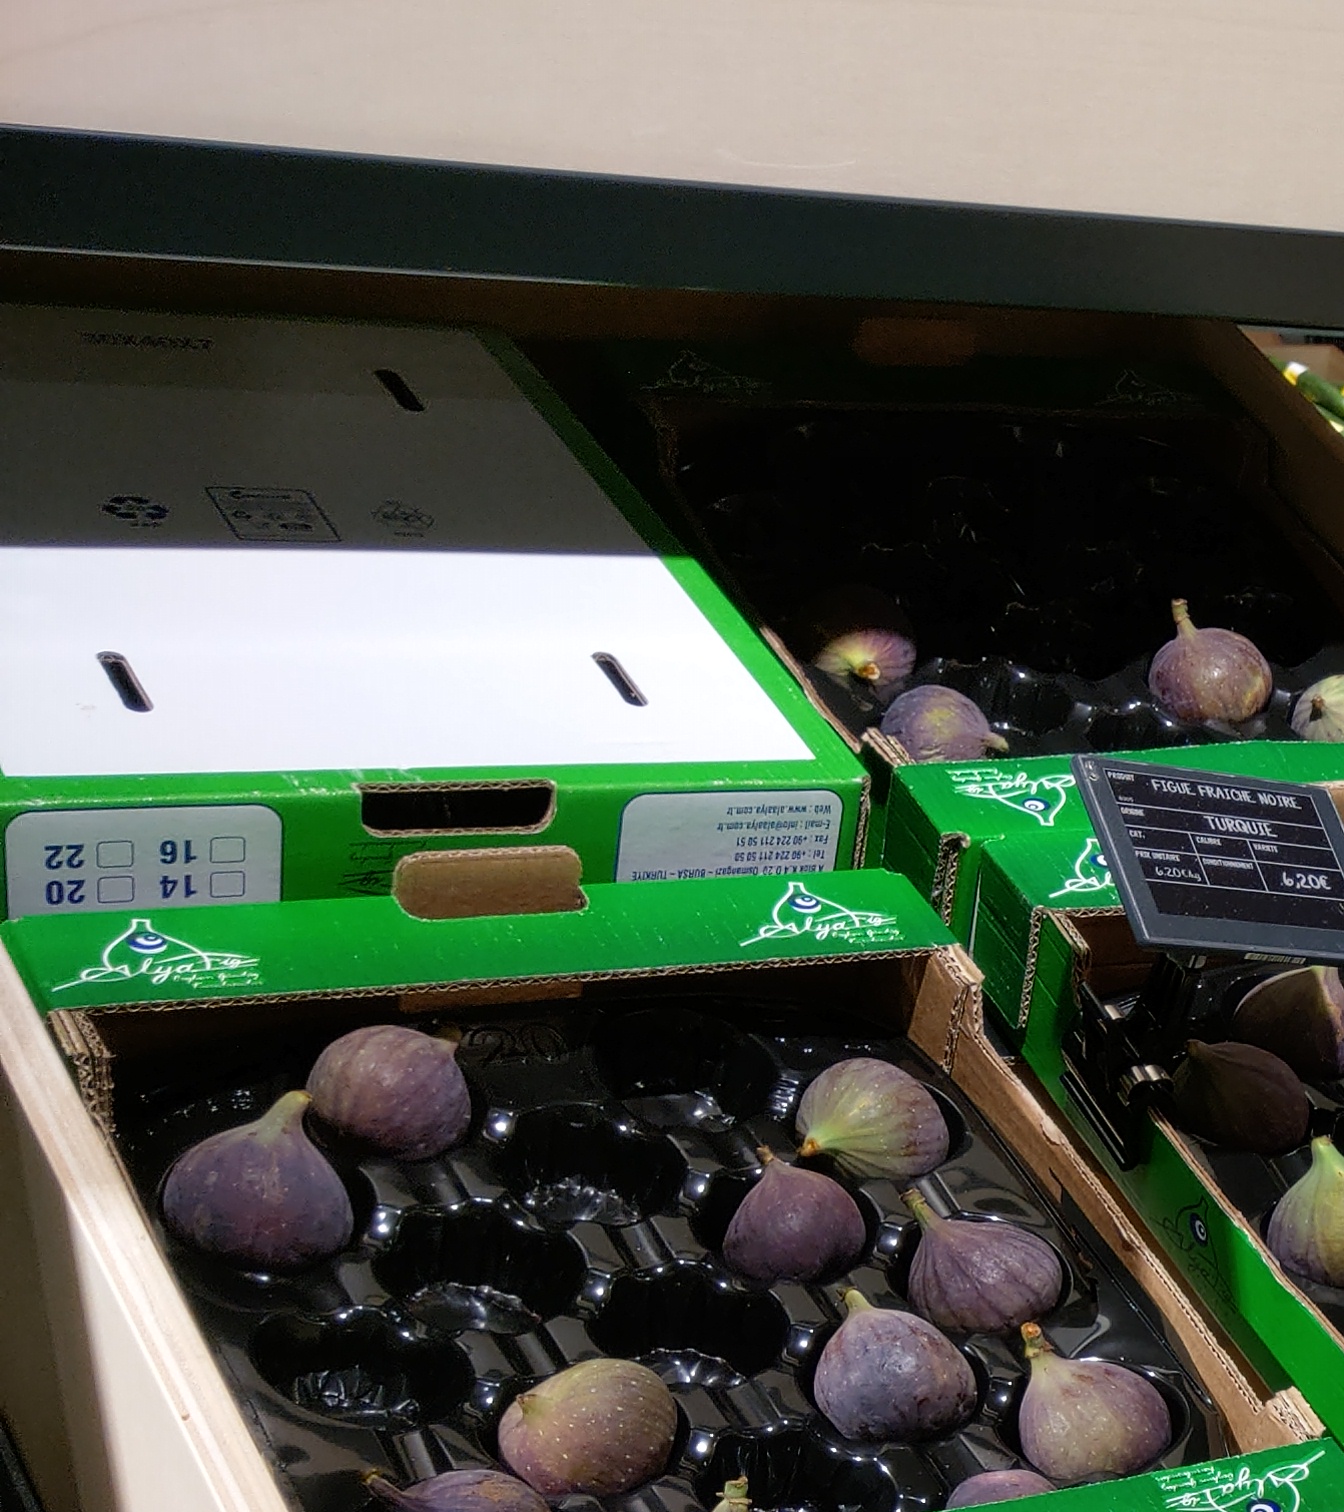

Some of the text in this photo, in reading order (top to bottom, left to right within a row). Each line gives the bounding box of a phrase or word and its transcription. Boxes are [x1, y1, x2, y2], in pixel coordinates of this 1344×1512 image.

[1151, 779, 1302, 810] FIGUE FRAICHE NOIRE
[1203, 815, 1278, 837] TURQUIE
[777, 836, 791, 846] 224
[44, 839, 197, 870] 16 22
[777, 850, 790, 860] 224
[678, 868, 705, 879] BURSA
[45, 874, 197, 905] 14 20
